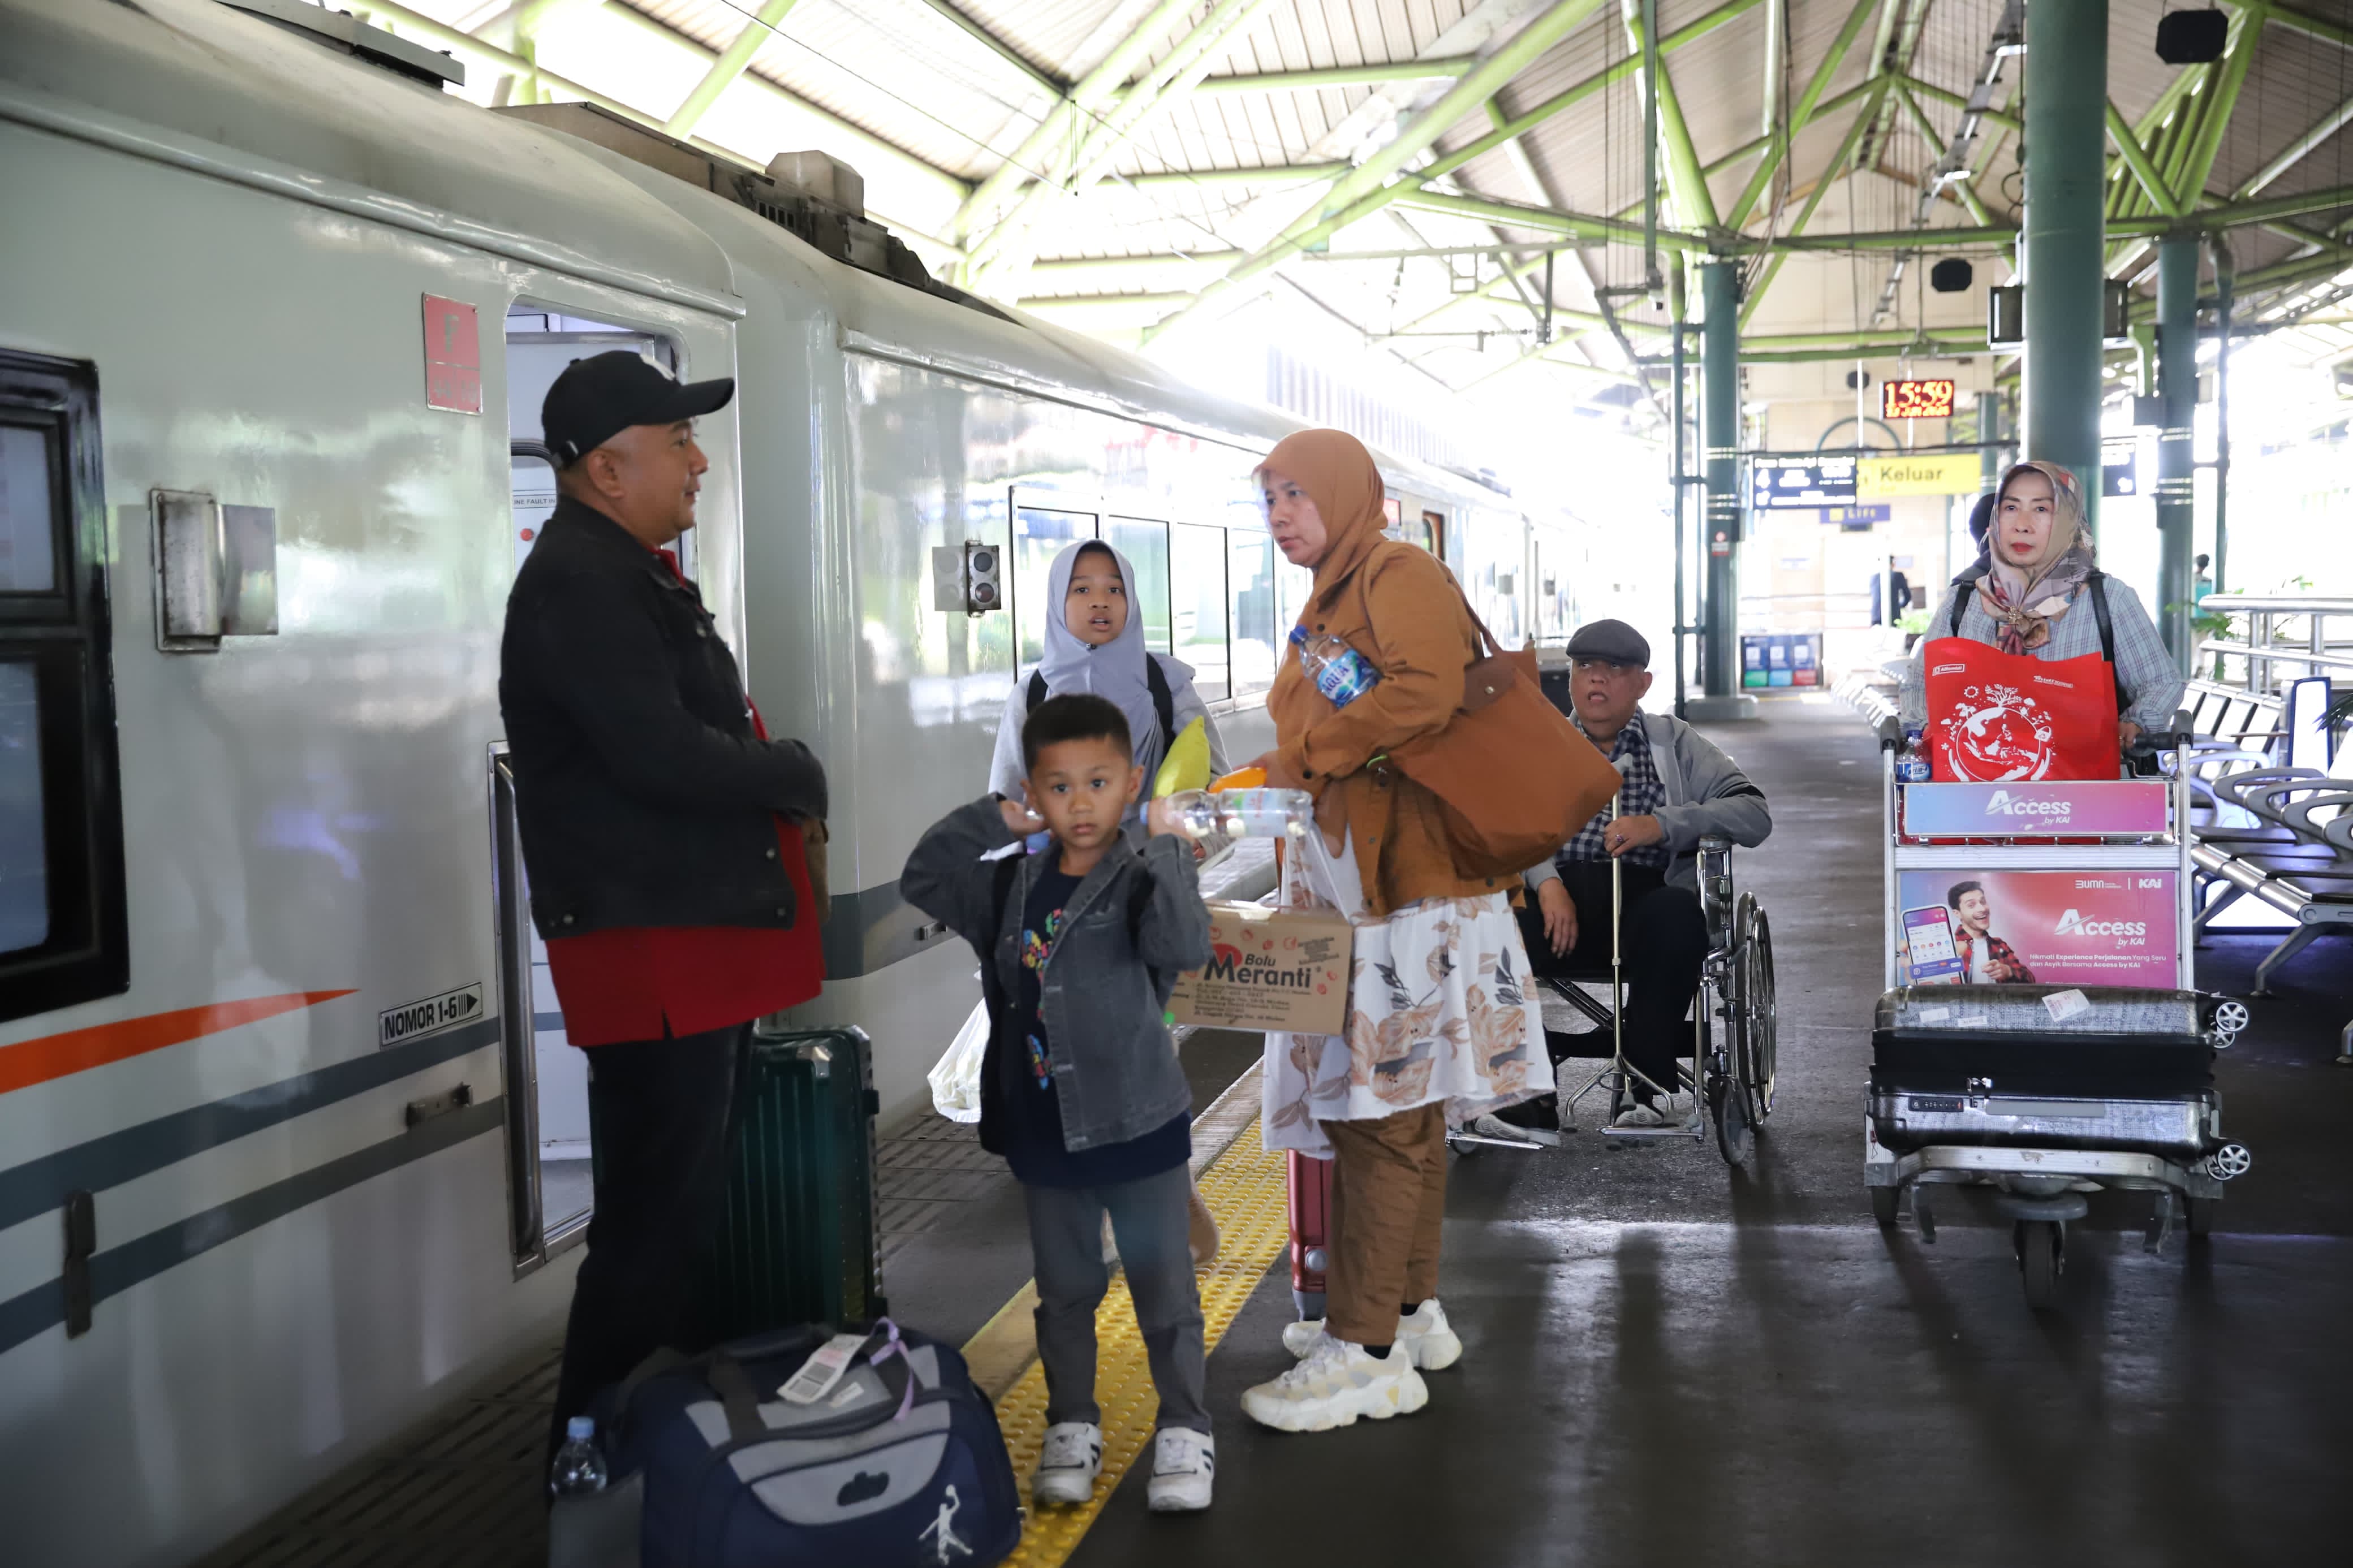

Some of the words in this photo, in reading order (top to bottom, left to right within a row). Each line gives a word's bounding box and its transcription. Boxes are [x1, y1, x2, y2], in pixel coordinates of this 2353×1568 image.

[1885, 381, 1953, 408] 15:59
[1880, 465, 1945, 482] Keluar
[1321, 664, 1350, 693] AQUA
[1984, 790, 2072, 815] Access
[2138, 878, 2162, 889] KAI
[2054, 909, 2147, 936] Access
[2118, 937, 2128, 946] by
[1203, 952, 1312, 988] Meranti
[1244, 953, 1277, 967] Bolu
[384, 1003, 435, 1040] NOMOR
[438, 996, 458, 1022] 1-6
